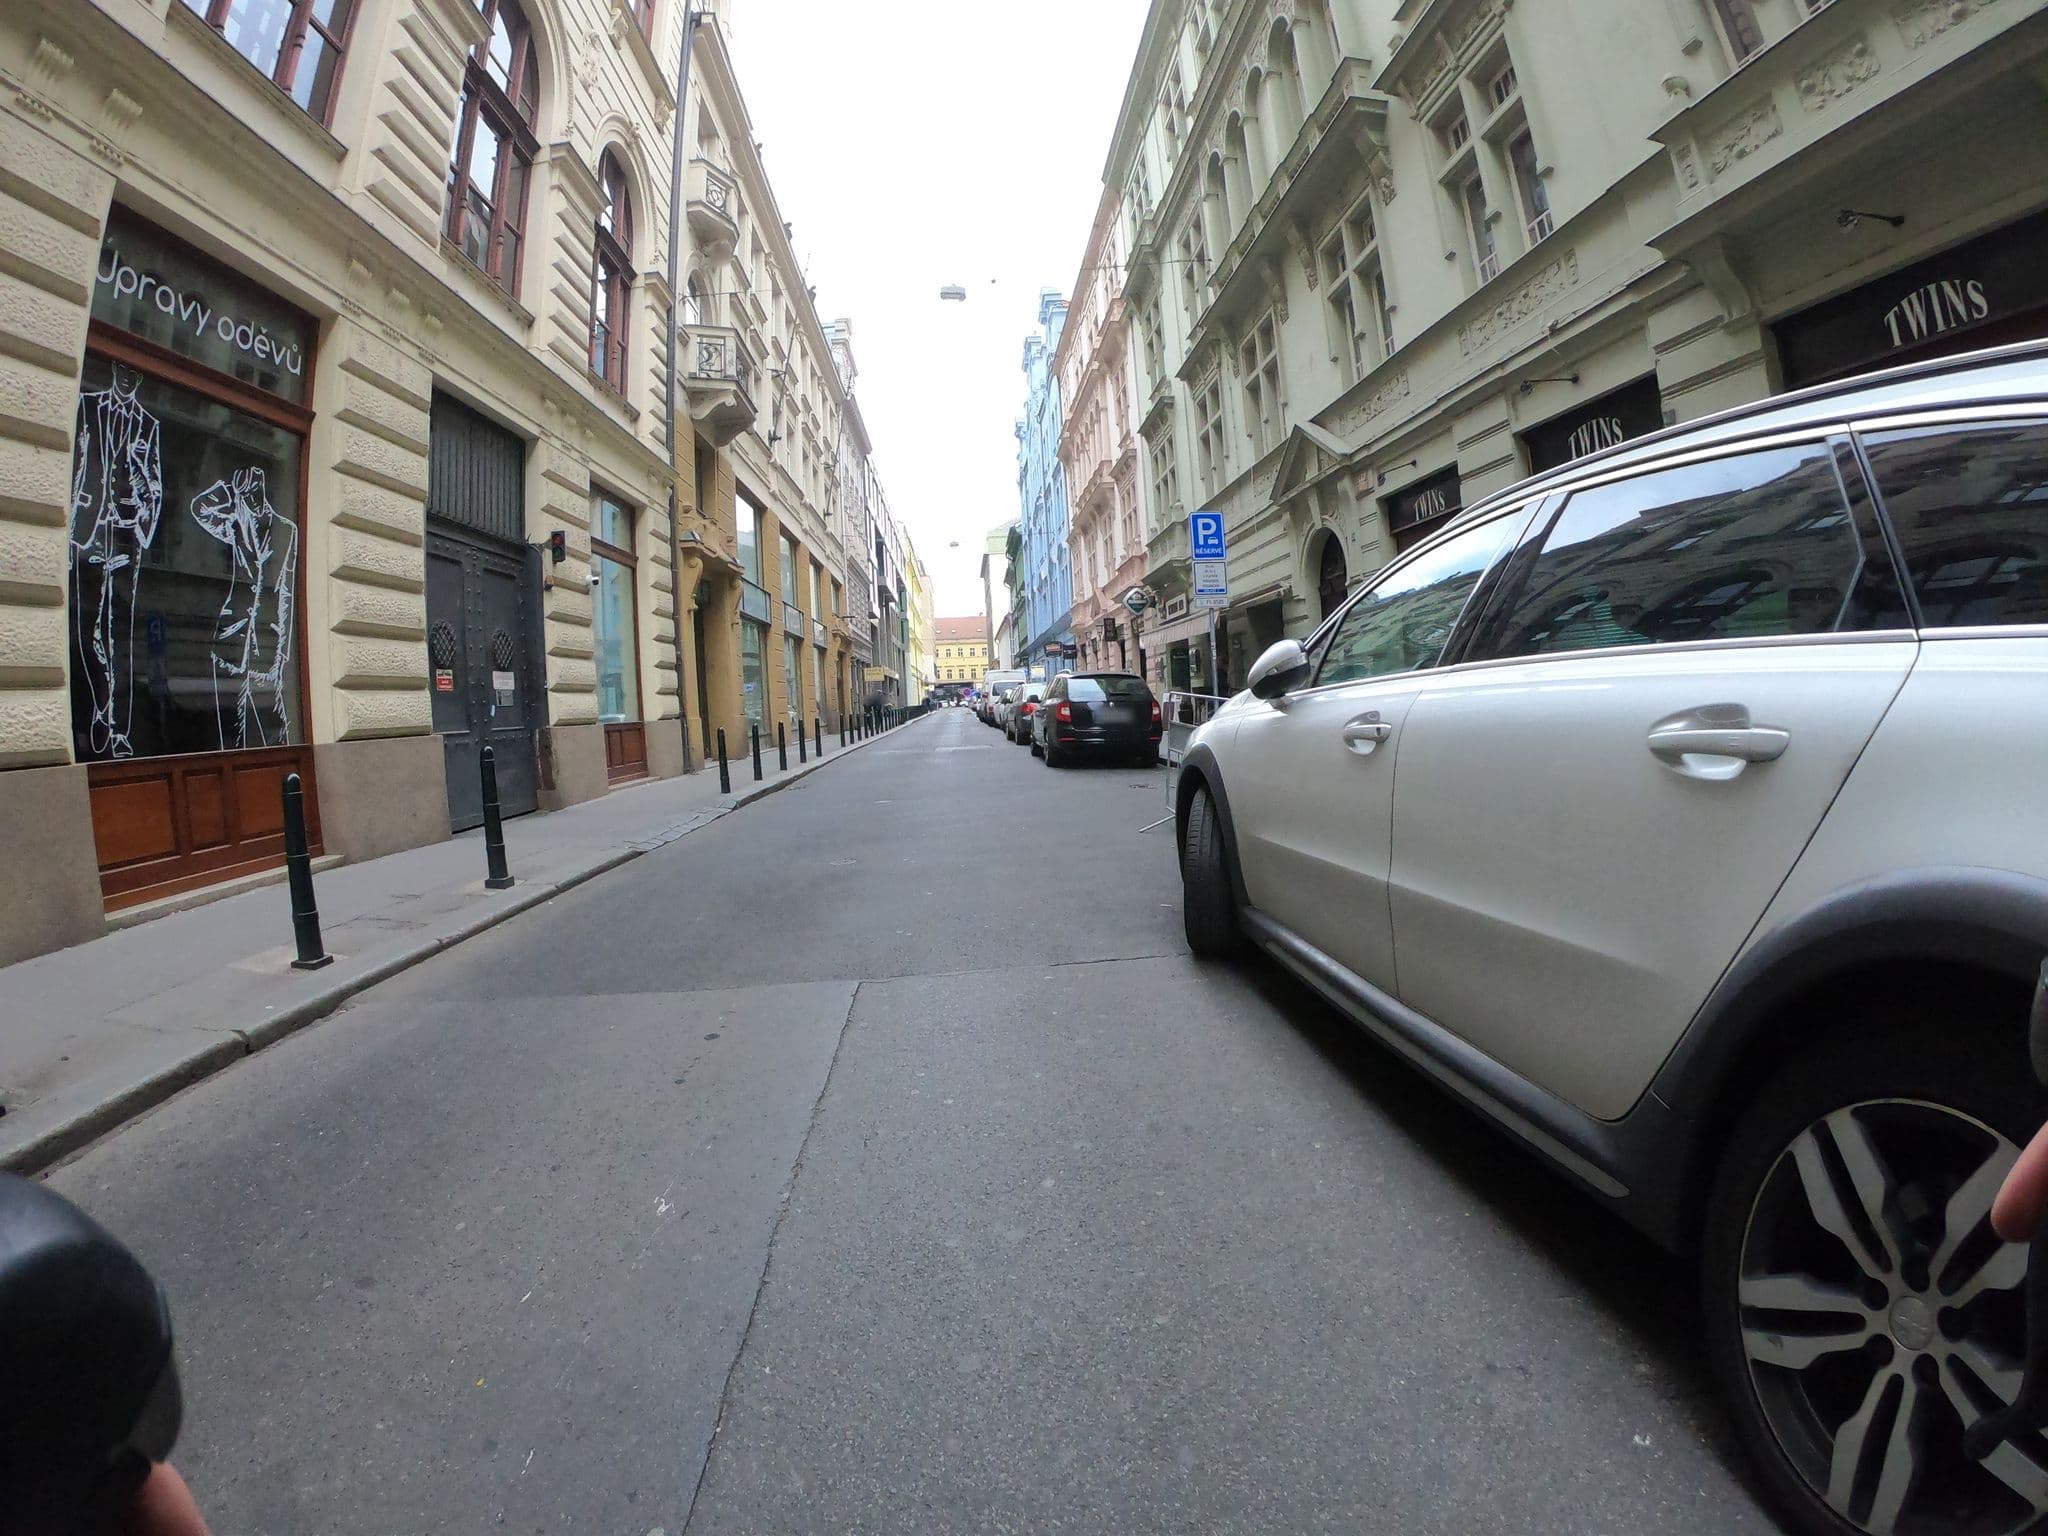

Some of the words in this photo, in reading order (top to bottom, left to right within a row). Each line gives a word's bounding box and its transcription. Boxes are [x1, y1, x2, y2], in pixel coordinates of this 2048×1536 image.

[1883, 279, 1989, 347] TWINS
[217, 315, 302, 376] oděvů
[1567, 416, 1624, 460] TWINS
[1413, 489, 1446, 521] TWINS
[1197, 518, 1217, 545] P
